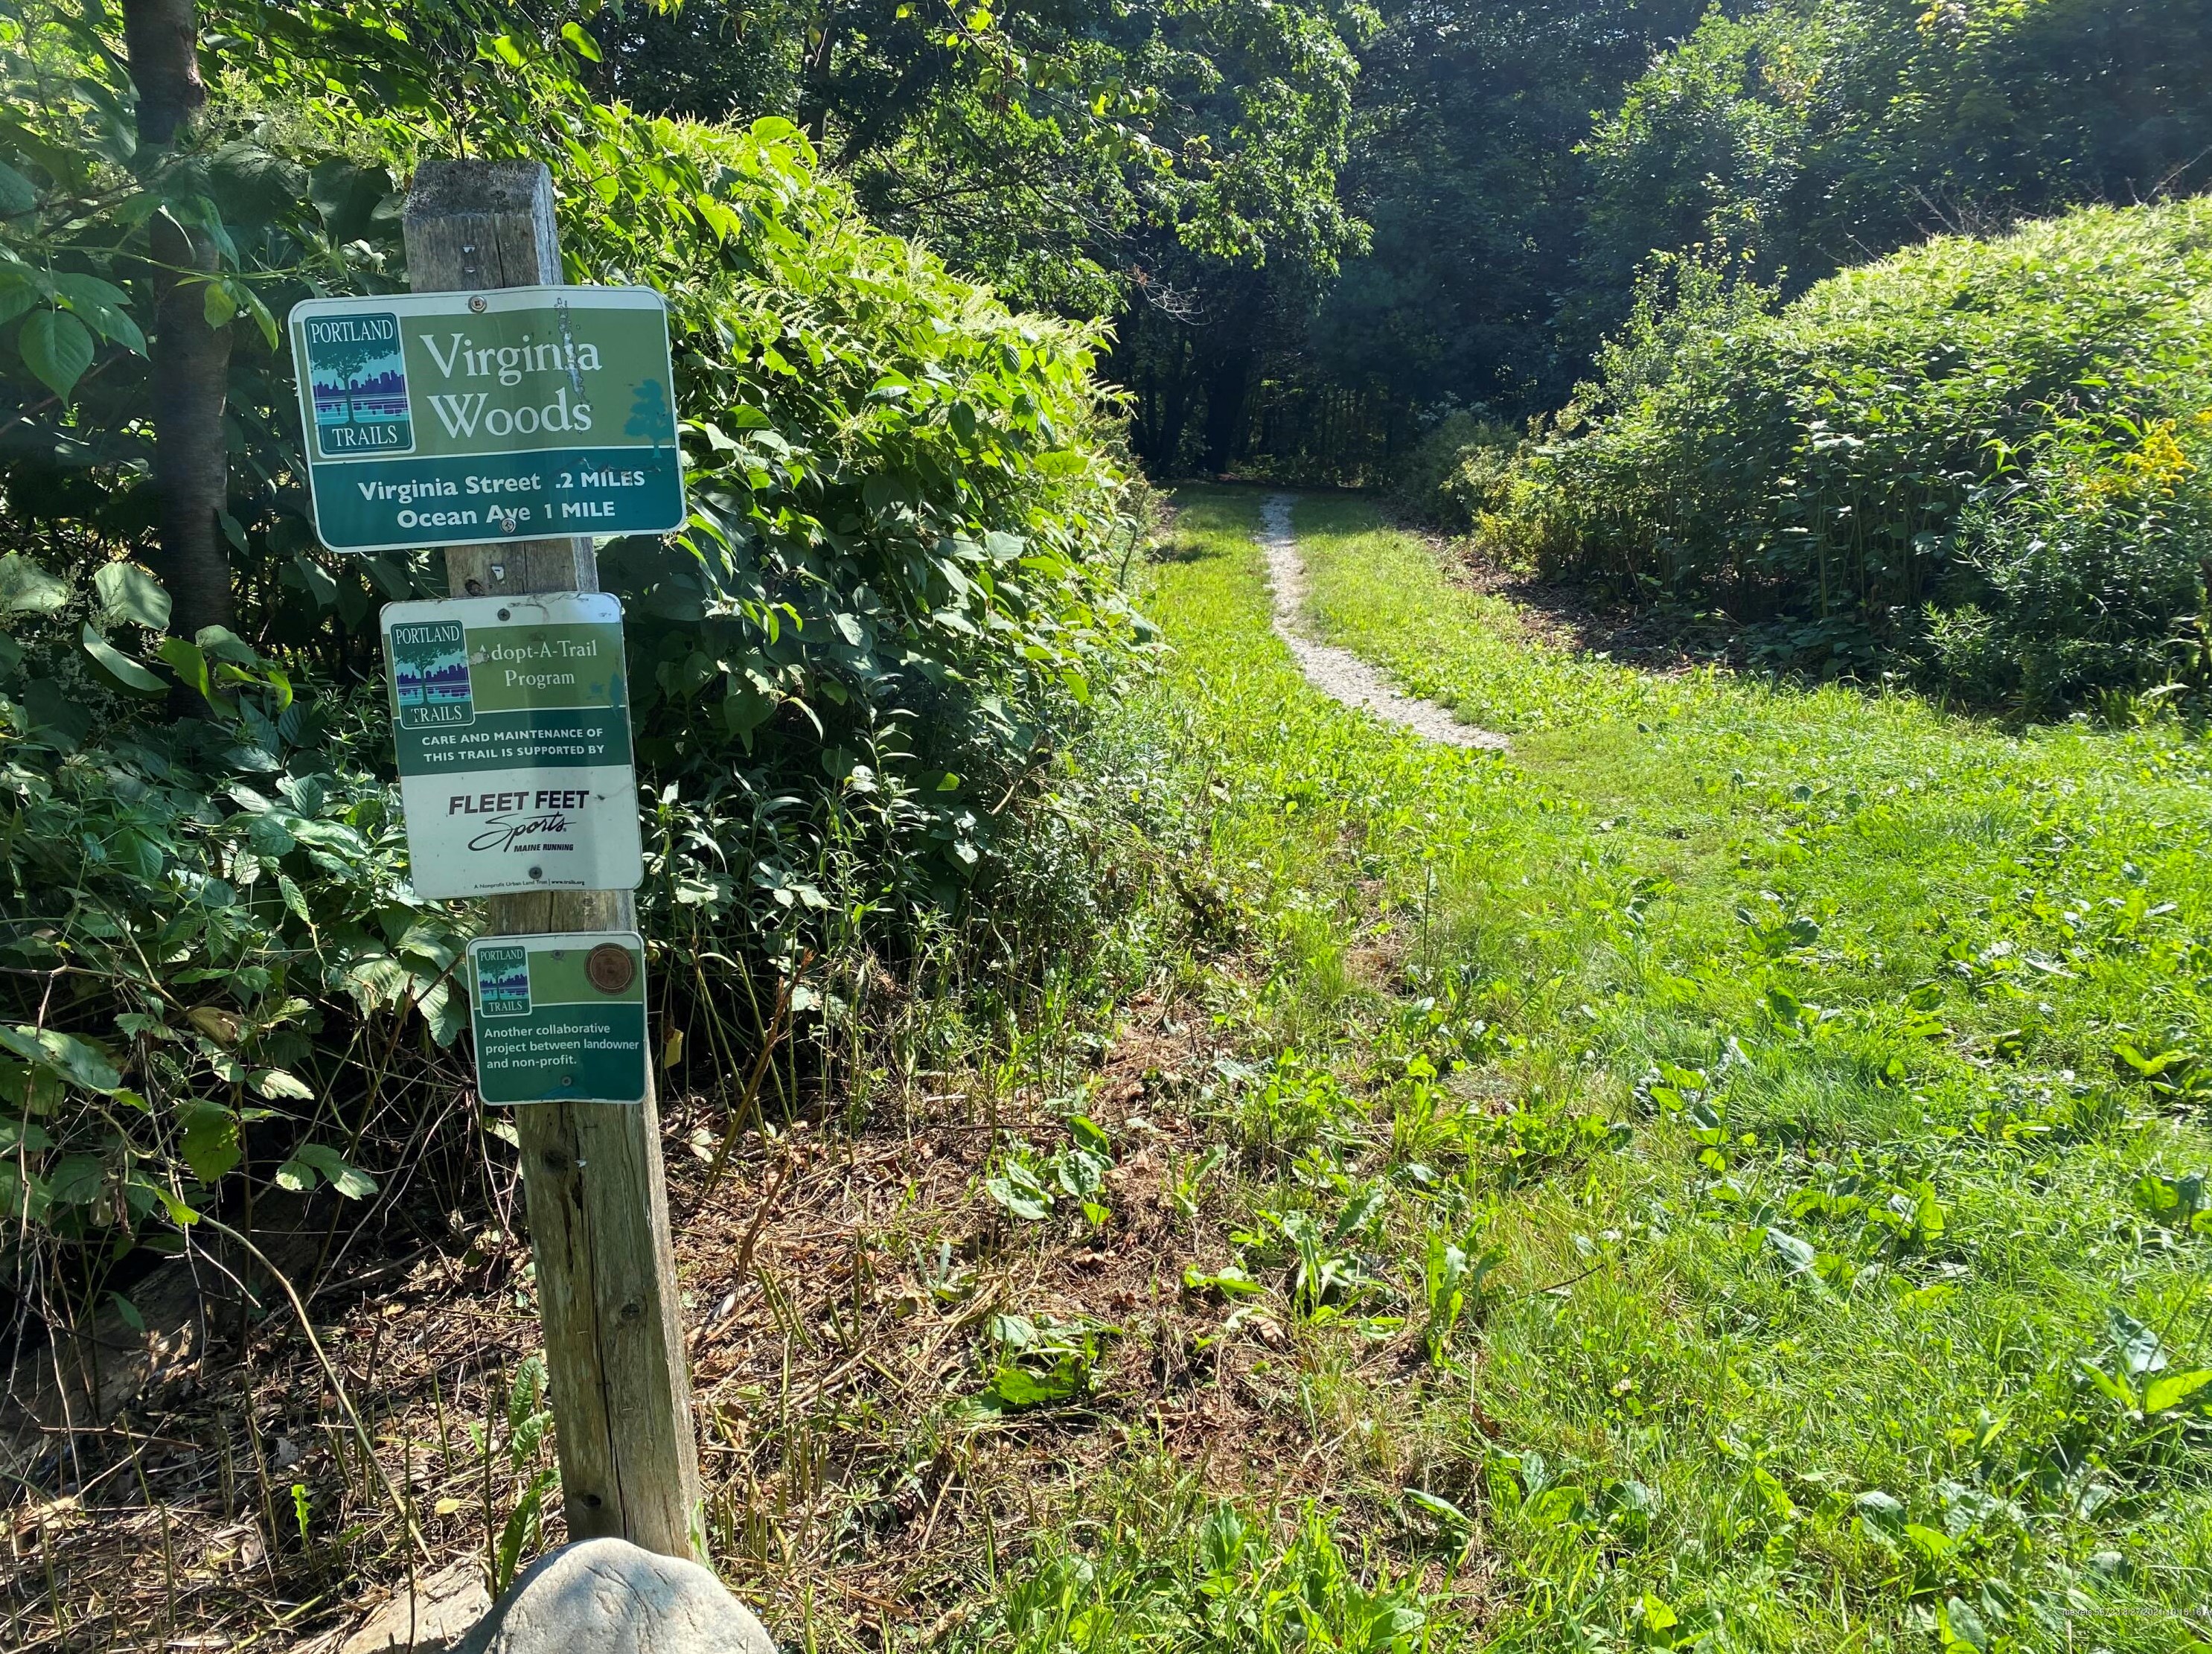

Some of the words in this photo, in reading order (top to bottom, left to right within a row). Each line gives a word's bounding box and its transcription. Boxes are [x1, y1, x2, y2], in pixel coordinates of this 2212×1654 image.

[310, 319, 393, 343] PORTLAND
[418, 333, 602, 386] Virginia
[426, 387, 592, 438] Woods
[332, 425, 397, 447] TRAILS
[358, 478, 458, 504] Virginia
[465, 473, 541, 494] Street
[555, 473, 573, 489] .2
[581, 471, 645, 488] MILES
[397, 508, 478, 529] Ocean
[486, 505, 531, 523] Ave
[544, 504, 552, 520] 1
[561, 502, 616, 518] MILE
[395, 626, 460, 645] PORTLAND
[505, 670, 575, 689] Program
[411, 705, 462, 723] TRAILS
[422, 735, 456, 745] CARE
[461, 733, 490, 744] AND
[494, 729, 583, 741] MAINTENANCE
[586, 728, 604, 738] OF
[423, 752, 454, 762] THIS
[458, 749, 498, 760] TRAIL
[502, 747, 513, 757] IS
[517, 745, 585, 756] SUPPORTED
[588, 744, 605, 754] BY
[449, 791, 529, 815] FLEET
[535, 790, 589, 809] FEET
[514, 844, 541, 852] MAINE
[480, 949, 523, 961] PORTLAND
[488, 1000, 522, 1012] TRAILS
[485, 1026, 532, 1038] Another
[536, 1023, 610, 1035] collaborative
[485, 1042, 526, 1056] project
[530, 1040, 581, 1051] between
[584, 1038, 639, 1050] landowner
[487, 1058, 508, 1069] and
[512, 1055, 577, 1068] non-profit.
